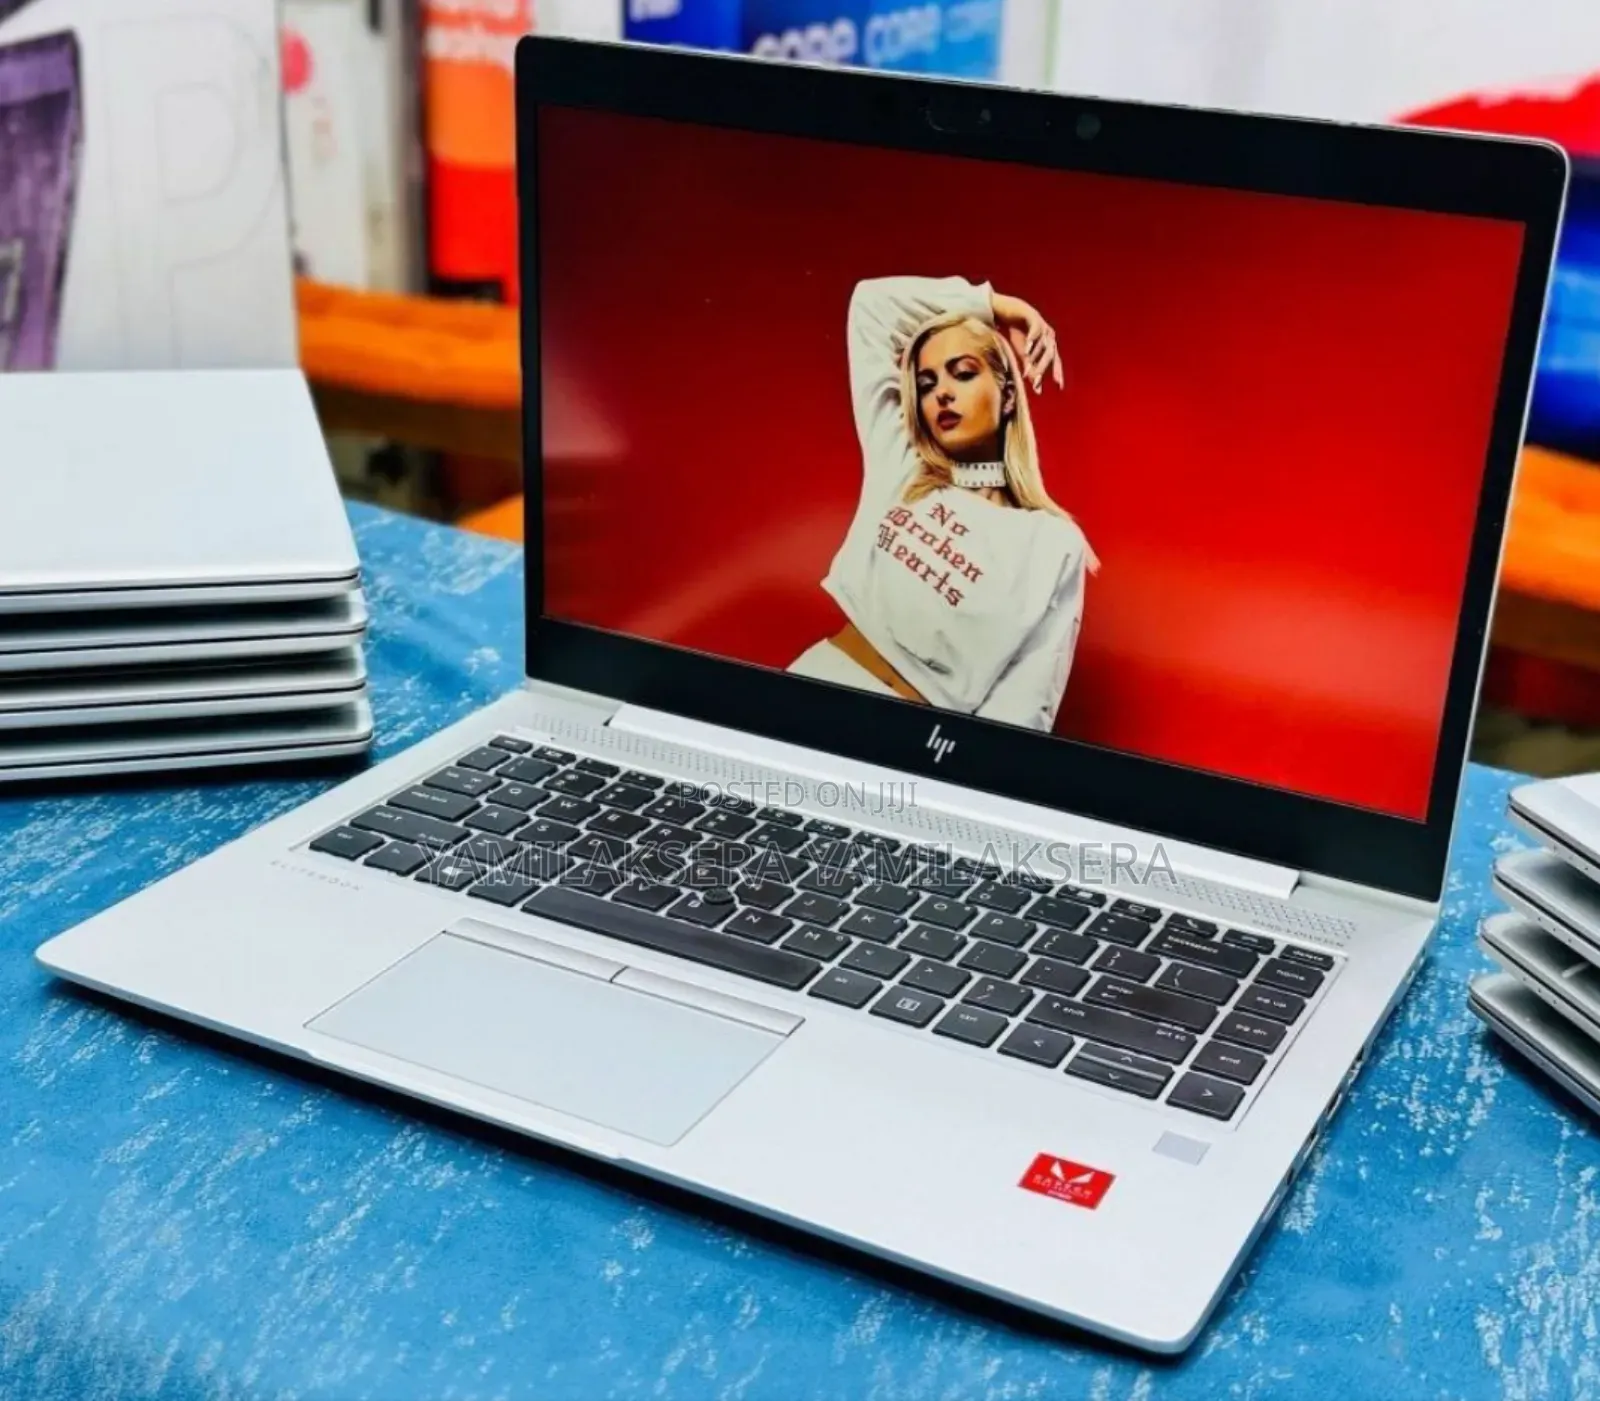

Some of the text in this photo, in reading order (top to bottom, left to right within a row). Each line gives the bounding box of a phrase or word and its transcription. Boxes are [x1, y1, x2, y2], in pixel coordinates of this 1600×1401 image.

[885, 506, 984, 583] Broken
[926, 502, 970, 537] No
[877, 523, 965, 607] Hearts
